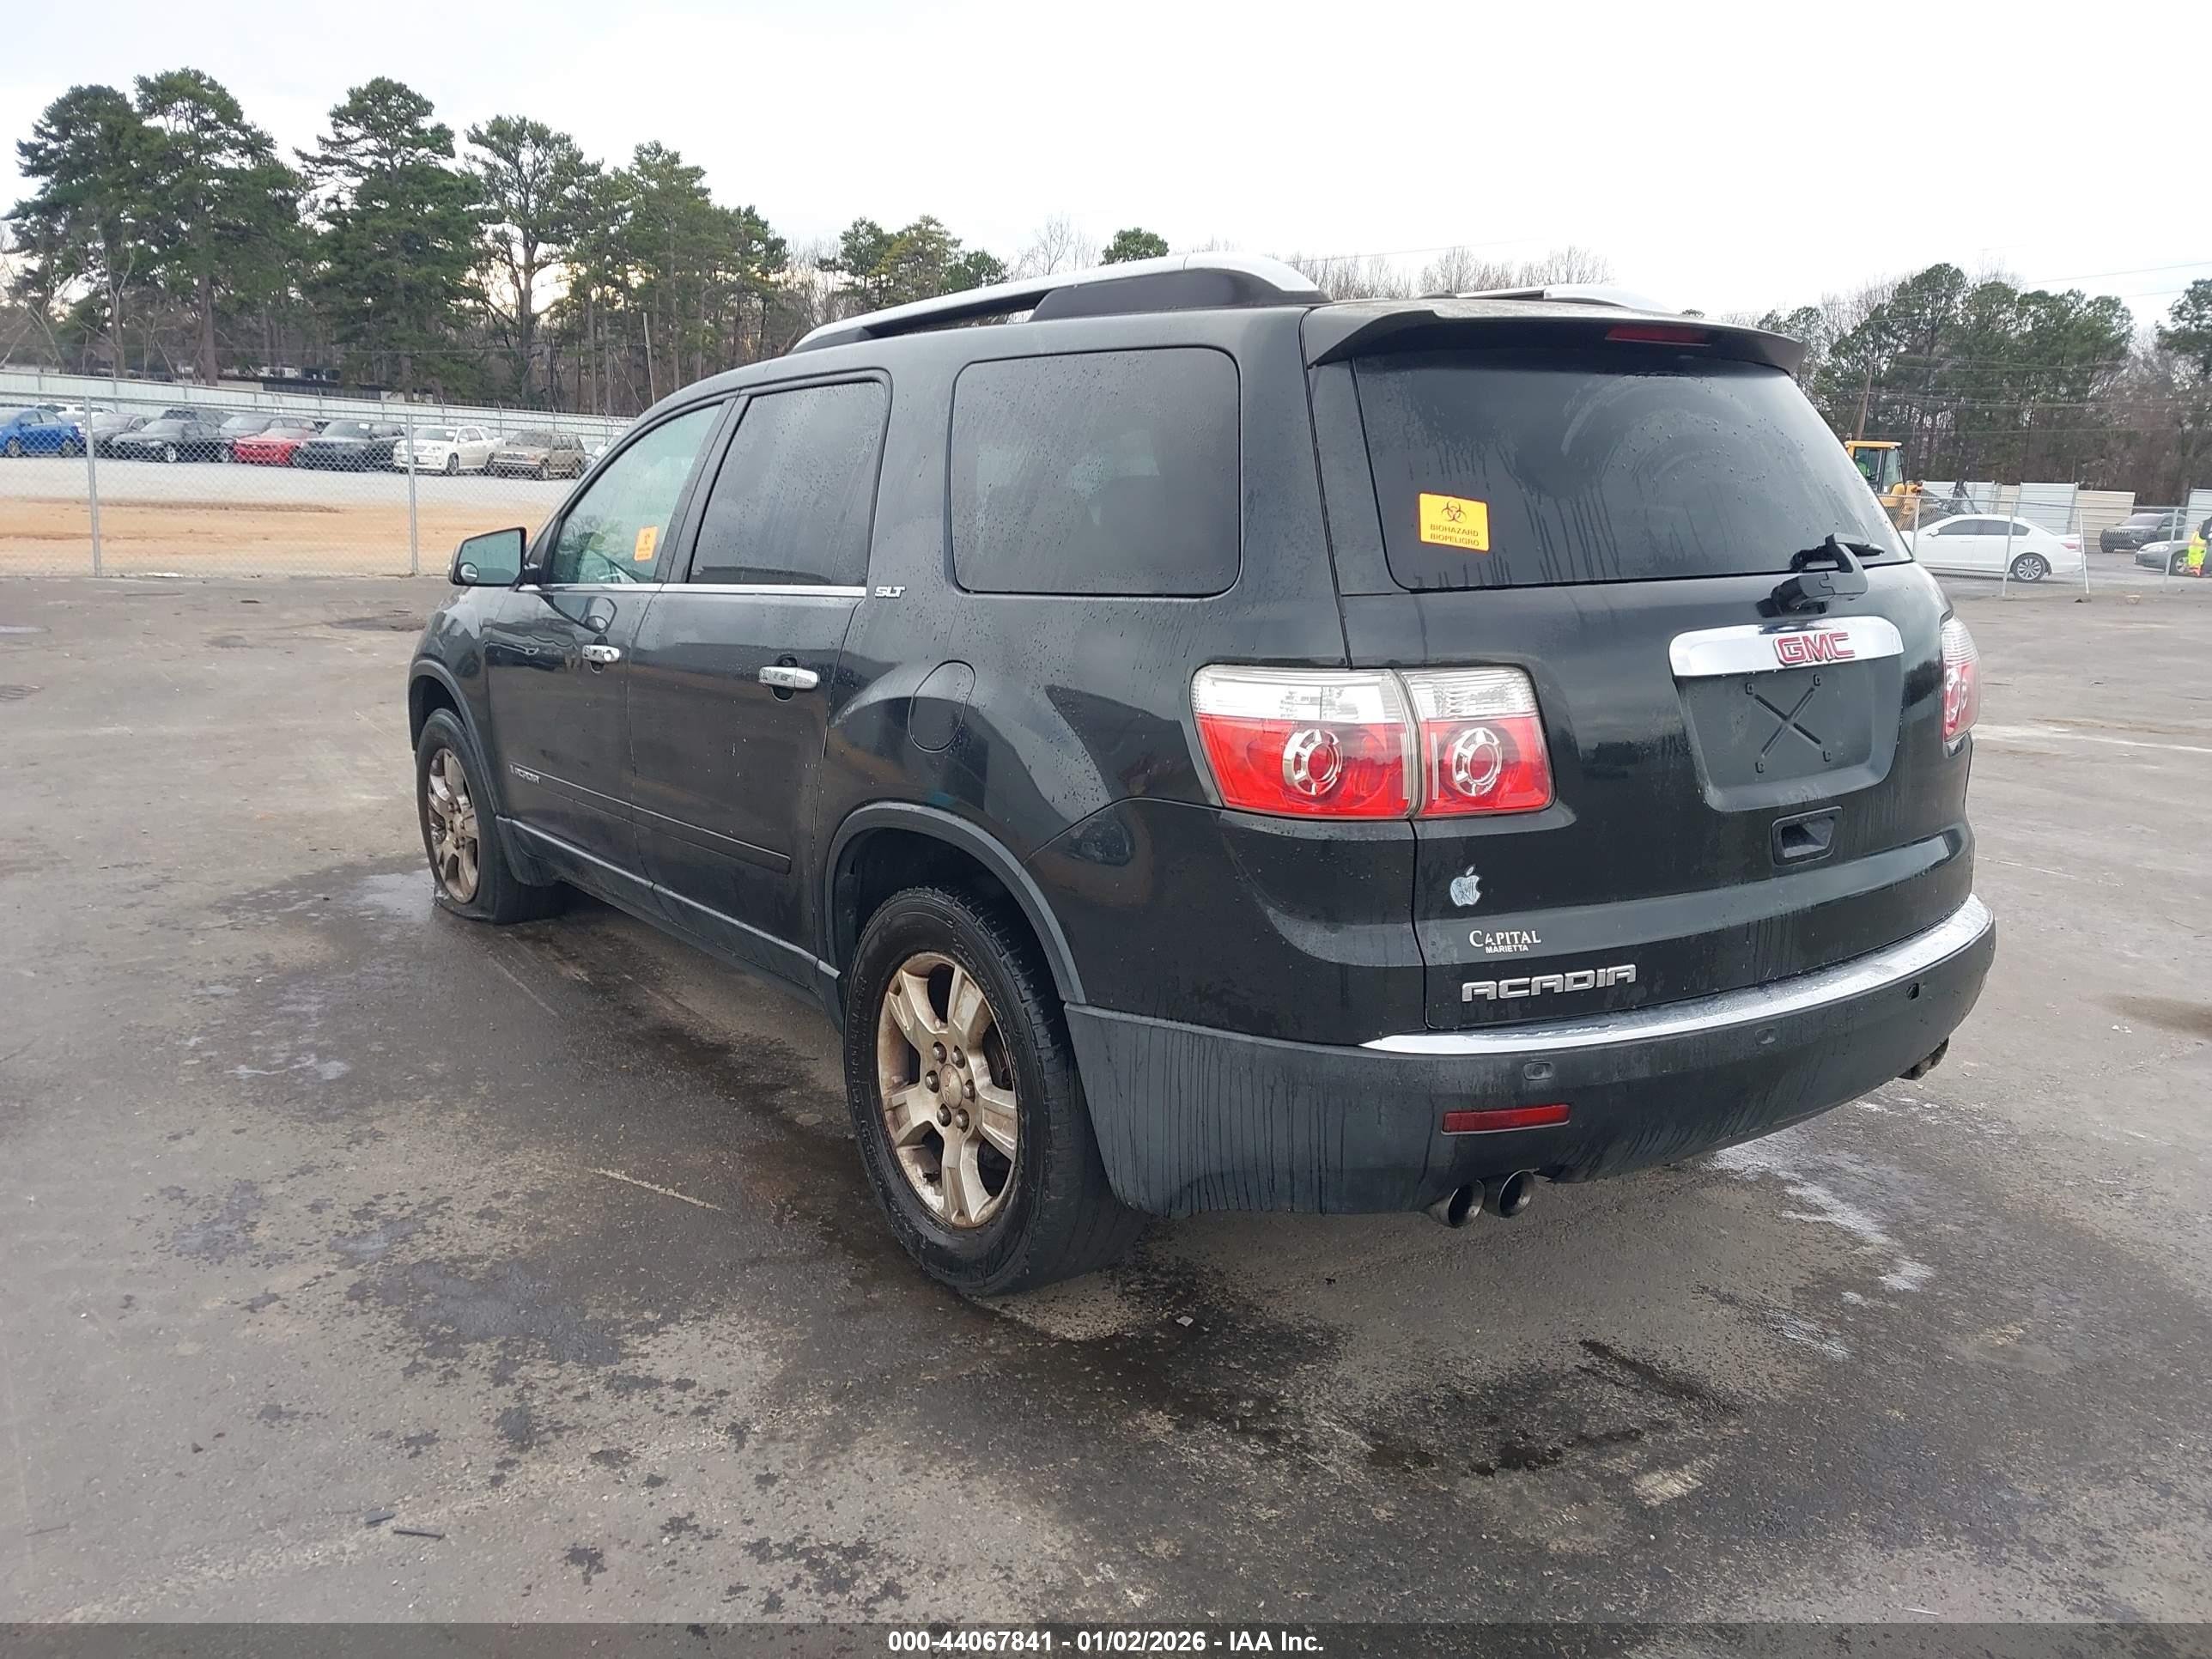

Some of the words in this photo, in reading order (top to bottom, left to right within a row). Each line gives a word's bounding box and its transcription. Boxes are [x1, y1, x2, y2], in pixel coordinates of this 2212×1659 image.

[1430, 523, 1479, 537] BIOHAZARD
[1430, 532, 1480, 547] BIOPELIGRO
[874, 586, 906, 598] SLT
[1774, 632, 1856, 666] GMC
[1485, 945, 1529, 954] MARIETTA
[1462, 963, 1637, 1003] ACADIA
